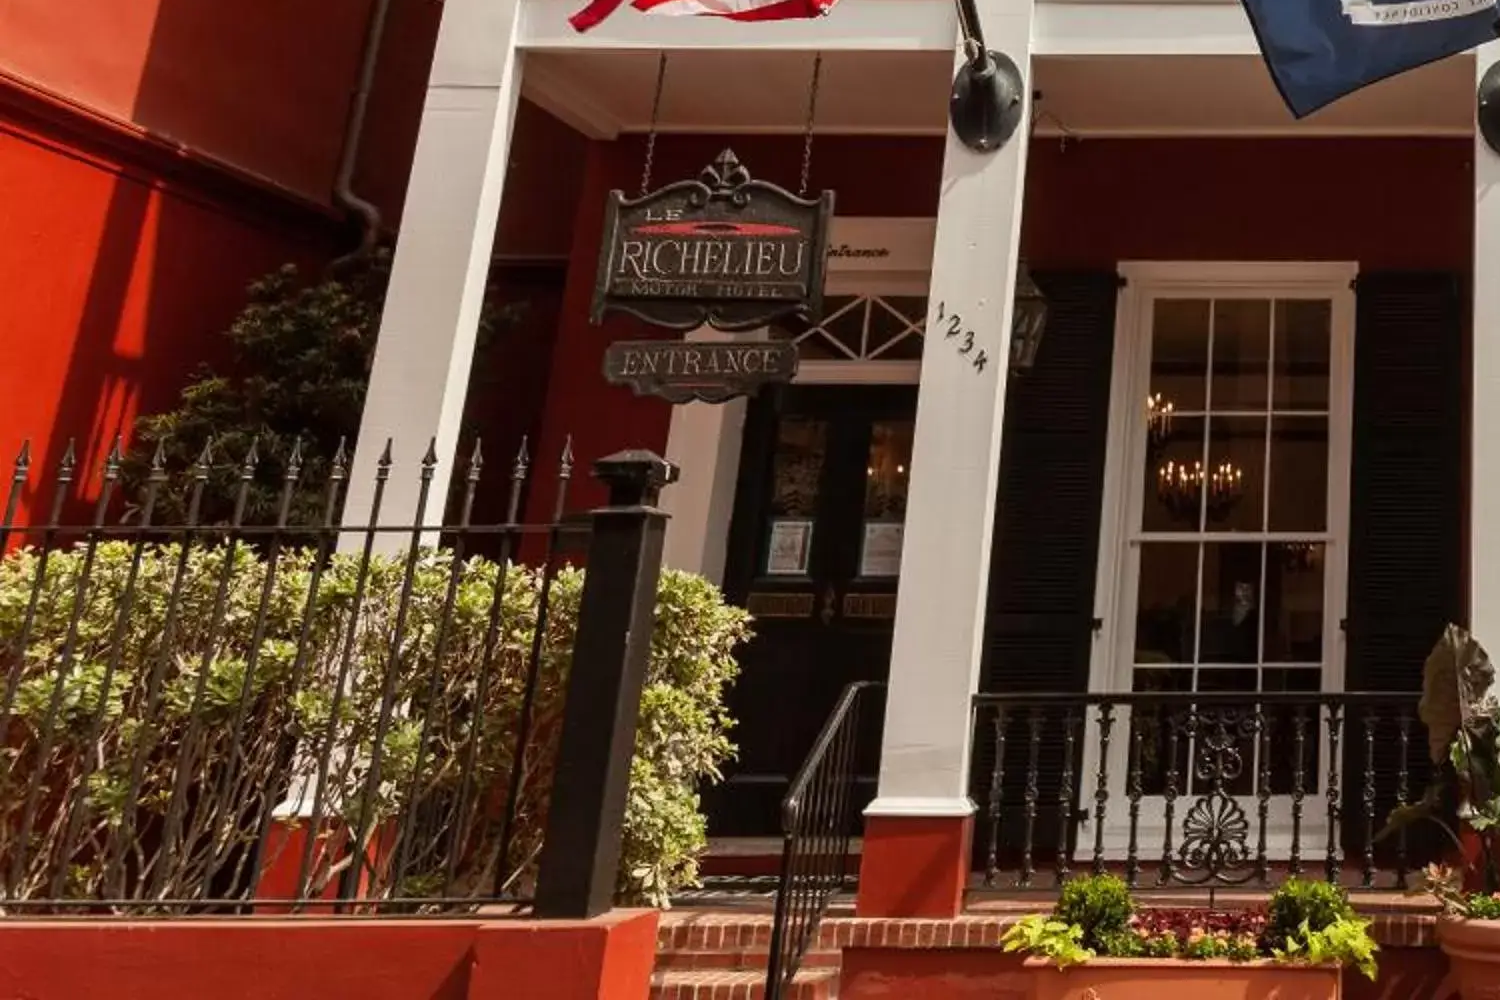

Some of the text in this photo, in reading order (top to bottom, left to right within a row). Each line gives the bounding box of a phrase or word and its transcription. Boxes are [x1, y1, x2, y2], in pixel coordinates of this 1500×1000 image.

[645, 208, 684, 221] LE
[617, 239, 808, 281] RICHELIEU
[631, 282, 783, 298] MOTOR HOTEL
[936, 301, 987, 375] 1234
[619, 349, 782, 376] ENTRANCE
